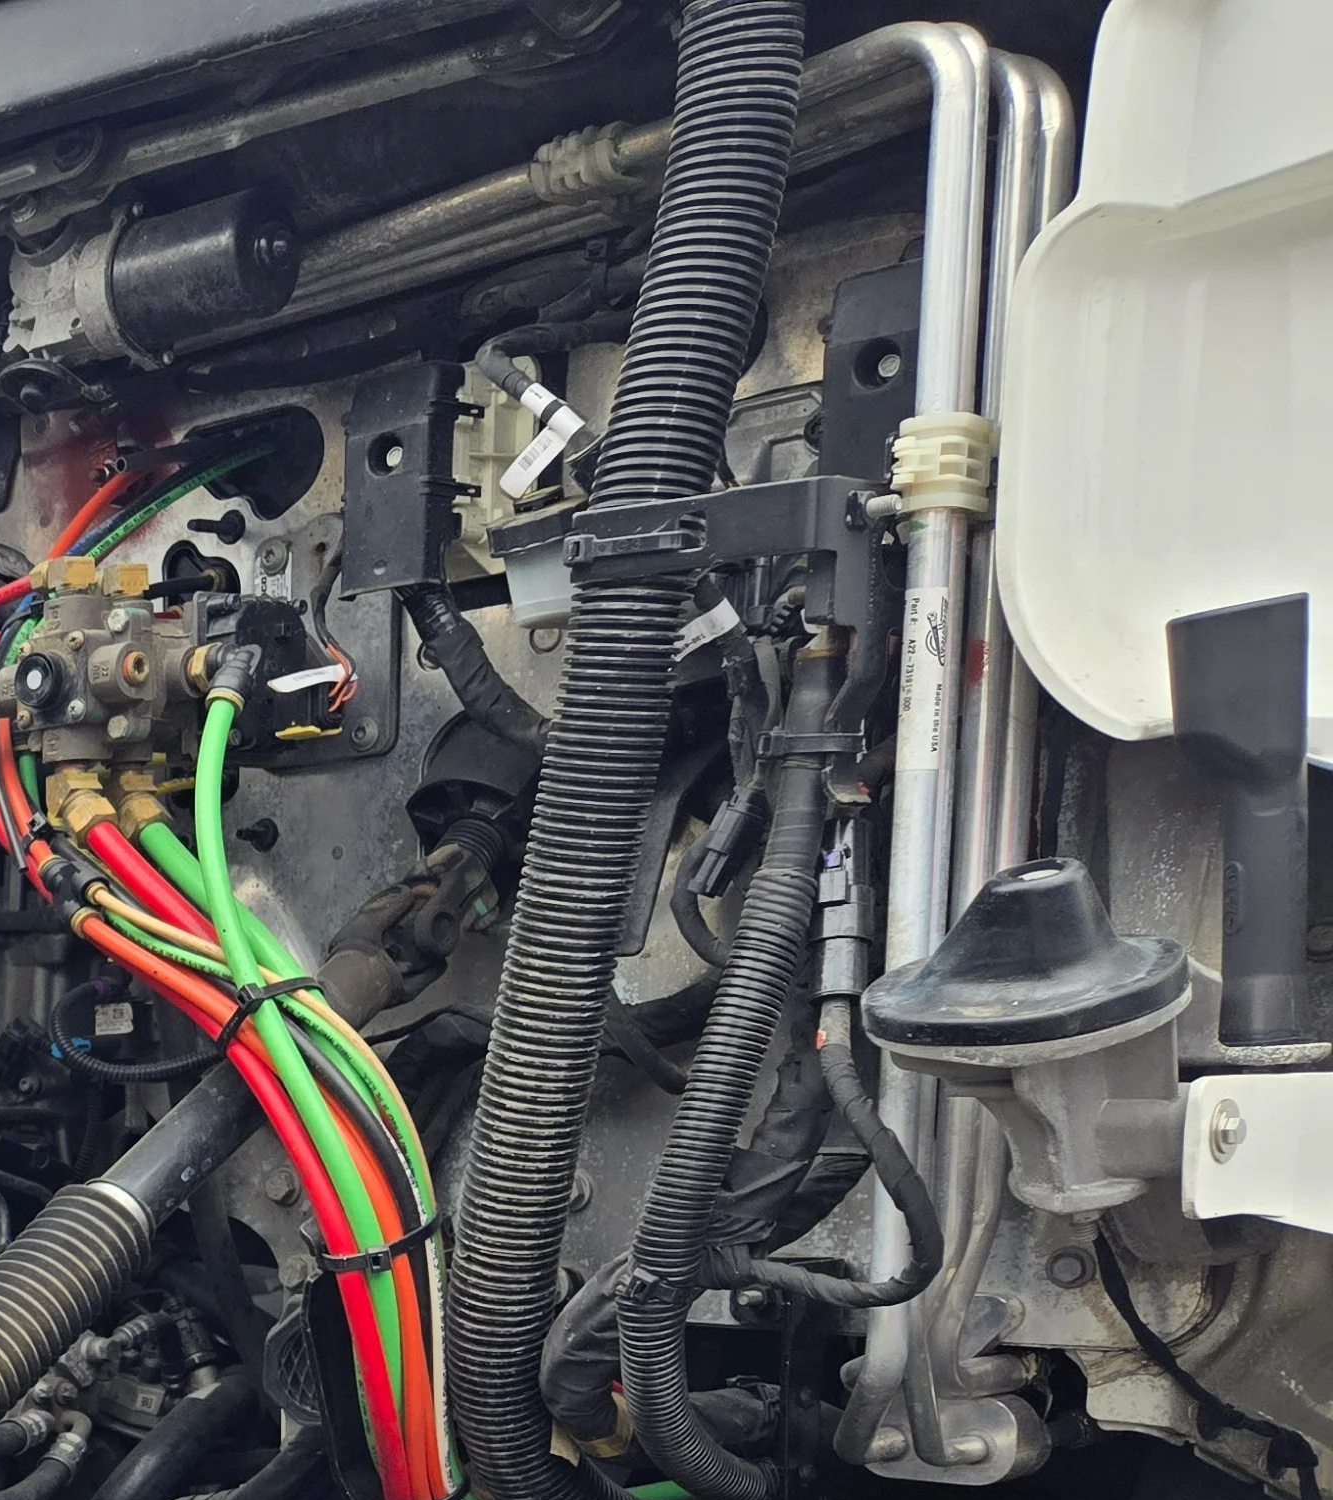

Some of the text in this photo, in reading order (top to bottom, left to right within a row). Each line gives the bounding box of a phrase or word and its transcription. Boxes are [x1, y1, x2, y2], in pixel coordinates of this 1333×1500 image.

[910, 597, 920, 617] Part
[935, 709, 940, 718] in
[931, 736, 939, 753] USA
